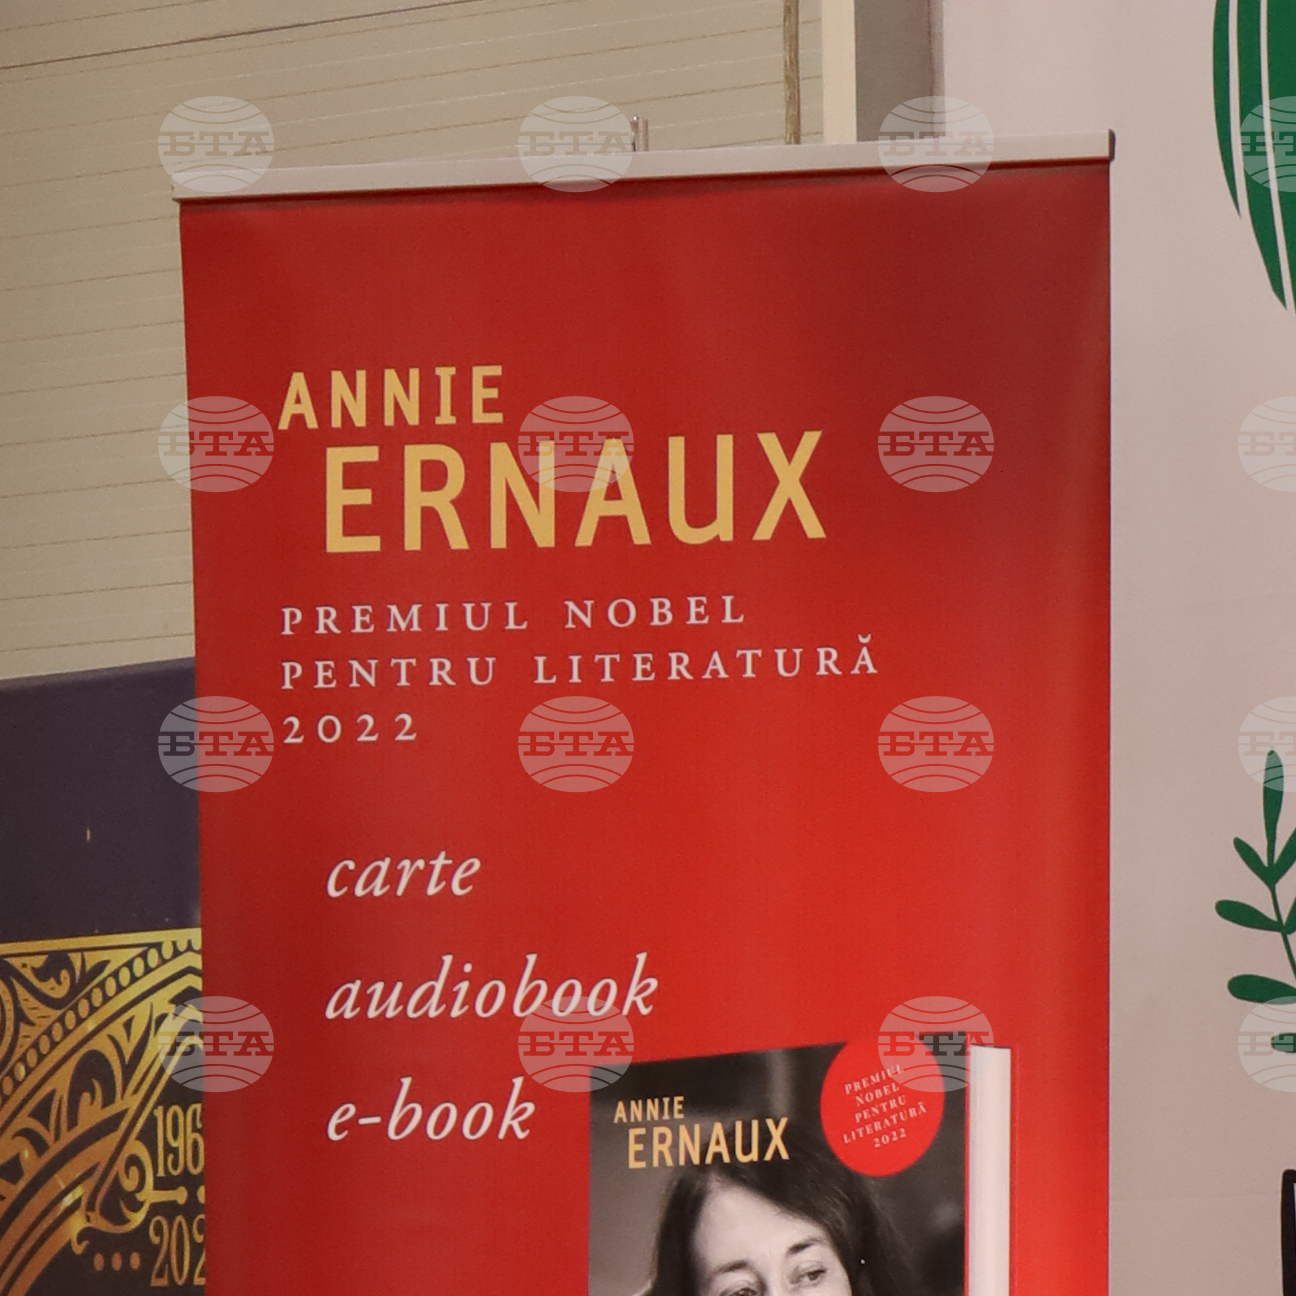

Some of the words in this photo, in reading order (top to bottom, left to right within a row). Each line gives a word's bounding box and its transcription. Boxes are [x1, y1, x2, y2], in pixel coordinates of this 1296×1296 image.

[278, 365, 504, 430] ANNIE
[325, 430, 826, 552] ERNAUX
[281, 600, 528, 636] PREMIUL
[564, 593, 746, 629] NOBEL
[281, 656, 498, 690] PENTRU
[533, 634, 880, 686] LITERATURĂ
[282, 711, 418, 744] 2022
[327, 850, 481, 898] carte
[324, 951, 659, 1020] audiobook
[845, 1064, 904, 1095] PREMIUL
[855, 1082, 899, 1107] NOBEL
[327, 1076, 535, 1141] e-book
[613, 1096, 685, 1123] ANNIE
[855, 1095, 906, 1123] PENTRU
[154, 1103, 205, 1177] 196
[628, 1117, 790, 1169] ERNAUX
[874, 1127, 907, 1148] 2022
